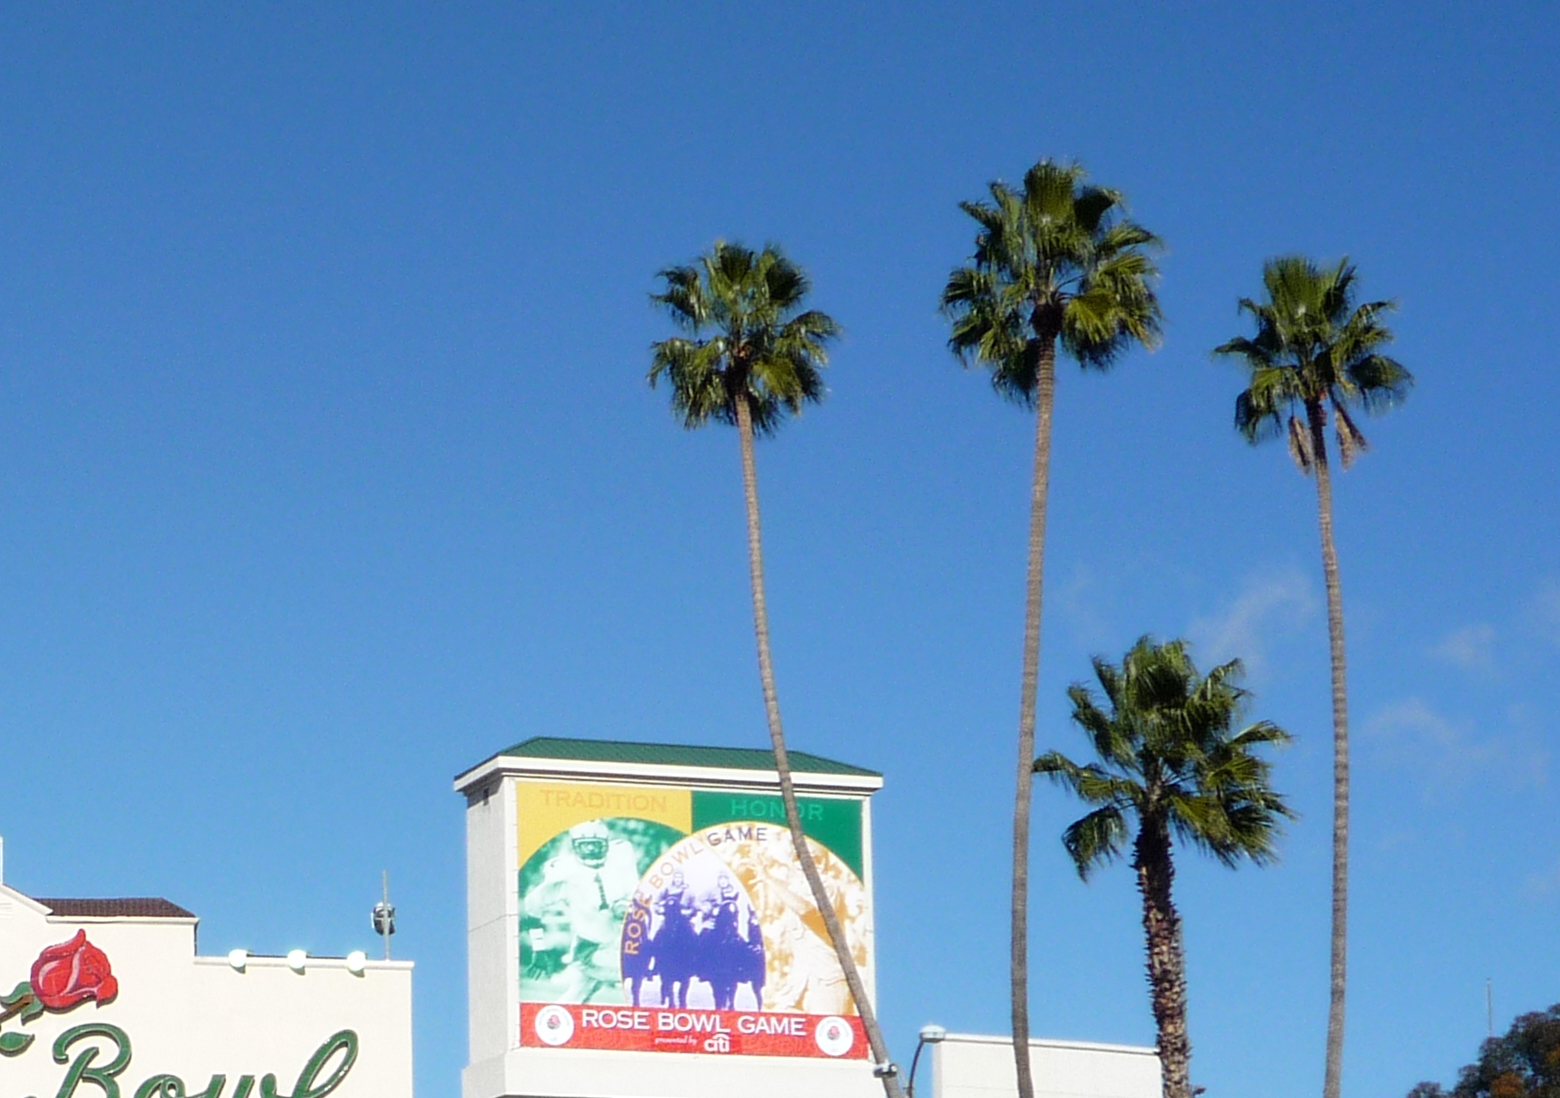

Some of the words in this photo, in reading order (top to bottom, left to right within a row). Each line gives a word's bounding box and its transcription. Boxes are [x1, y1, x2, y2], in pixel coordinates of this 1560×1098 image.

[540, 789, 667, 813] TRADITION
[624, 890, 653, 955] ROSE
[648, 843, 704, 889] BOWL
[707, 827, 768, 847] GAME
[581, 1010, 649, 1030] ROSE
[658, 1013, 731, 1032] BOWL
[737, 1016, 807, 1036] GAME
[655, 1035, 687, 1045] presented
[688, 1035, 698, 1046] by
[704, 1034, 730, 1052] citi
